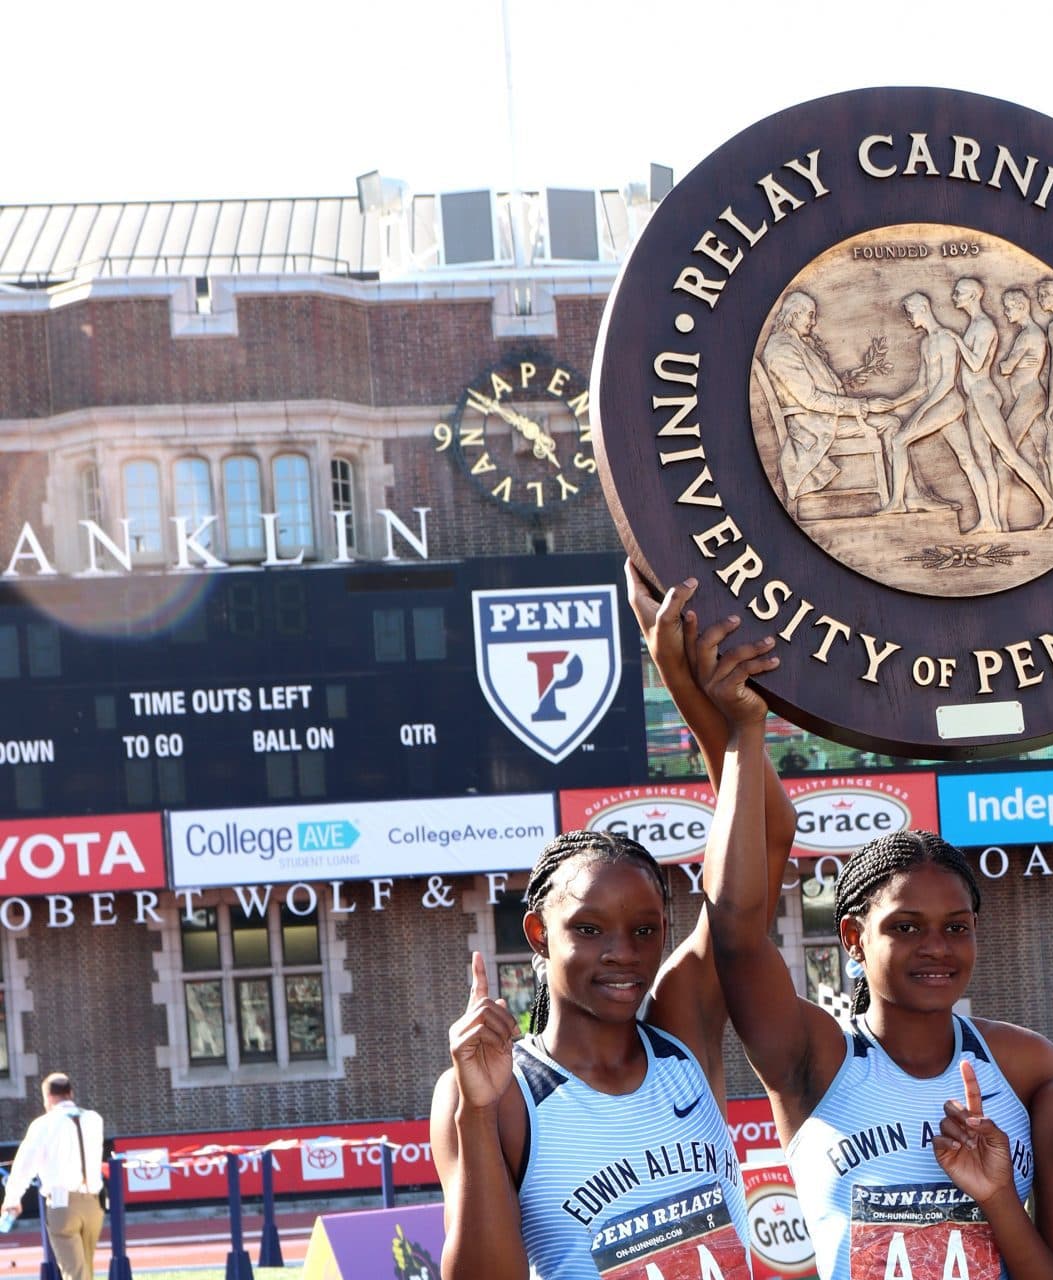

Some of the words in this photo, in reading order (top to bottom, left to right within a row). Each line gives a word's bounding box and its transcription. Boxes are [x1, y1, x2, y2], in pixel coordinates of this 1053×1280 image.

[673, 149, 831, 309] RELAY
[853, 246, 928, 259] FOUNDED
[942, 242, 980, 257] 1895
[652, 351, 901, 686] UNIVERSITY
[912, 655, 957, 689] OF
[489, 600, 603, 632] PENN
[130, 691, 186, 716] TIME
[192, 687, 252, 714] OUTS
[259, 685, 312, 711] LEFT
[123, 735, 149, 759] TO
[155, 733, 184, 757] GO
[253, 729, 302, 752] BALL
[306, 727, 334, 750] ON
[400, 723, 437, 749] QTR
[832, 777, 872, 788] SINCE
[585, 788, 640, 816] QUALITY
[646, 786, 687, 797] SINCE
[388, 823, 545, 848] CollegeAve.com
[796, 811, 892, 834] Grace
[186, 822, 293, 860] College
[303, 823, 345, 850] AVE
[233, 878, 394, 919] WOLF
[422, 874, 455, 909] &
[827, 1122, 908, 1177] EDWIN
[562, 1158, 641, 1227] EDWIN
[644, 1141, 718, 1180] ALLEN
[854, 1188, 918, 1206] PENN
[591, 1214, 649, 1251] PENN
[653, 1188, 723, 1226] RELAYS
[873, 1211, 944, 1221] ON-RUNNING.COM
[615, 1227, 684, 1259] ON-RUNNING.COM
